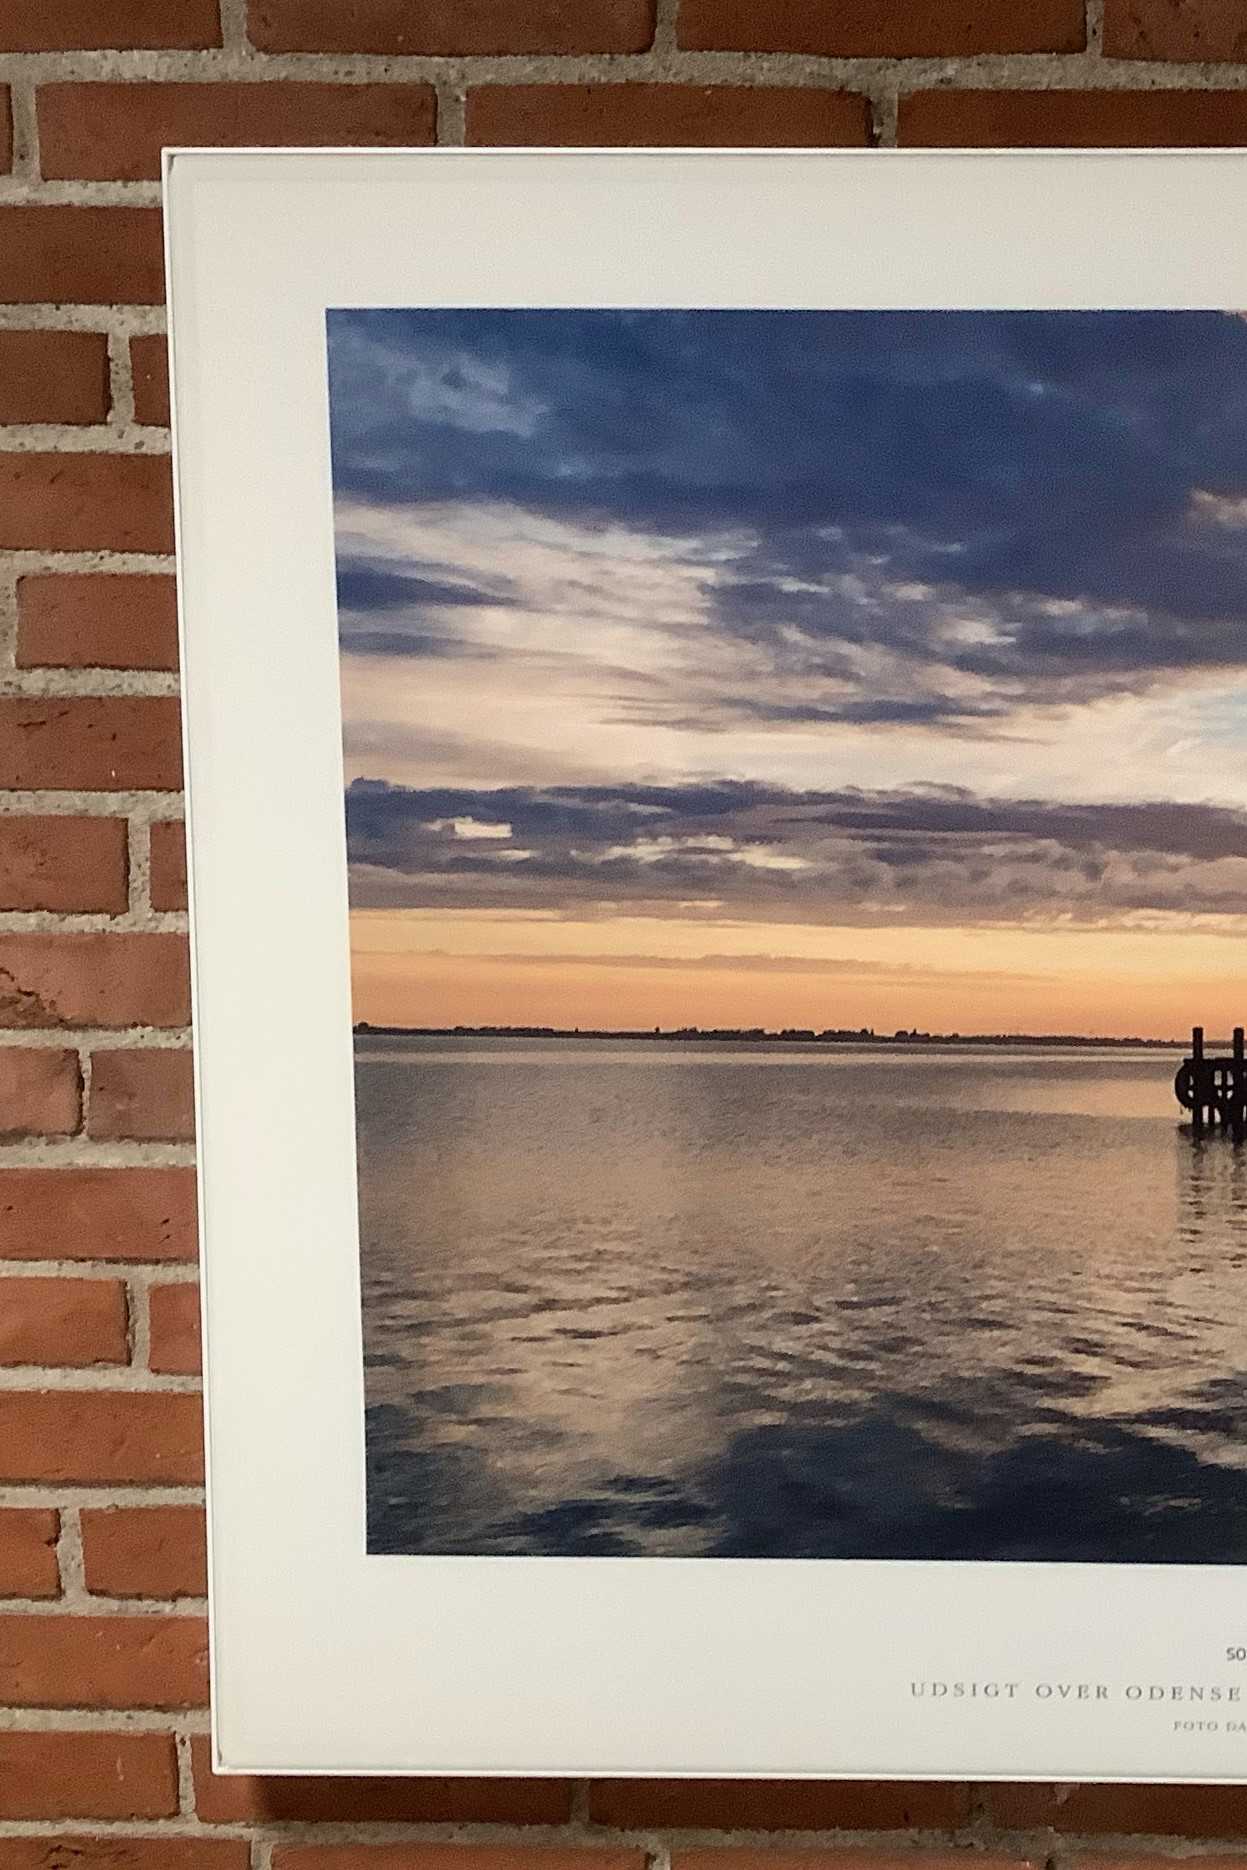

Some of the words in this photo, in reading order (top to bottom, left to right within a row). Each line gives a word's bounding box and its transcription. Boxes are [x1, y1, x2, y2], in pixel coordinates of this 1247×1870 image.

[910, 1682, 1020, 1698] UDSIGT
[1035, 1684, 1109, 1700] OVER
[1125, 1685, 1241, 1701] ODENSE
[1173, 1720, 1219, 1732] FOTO
